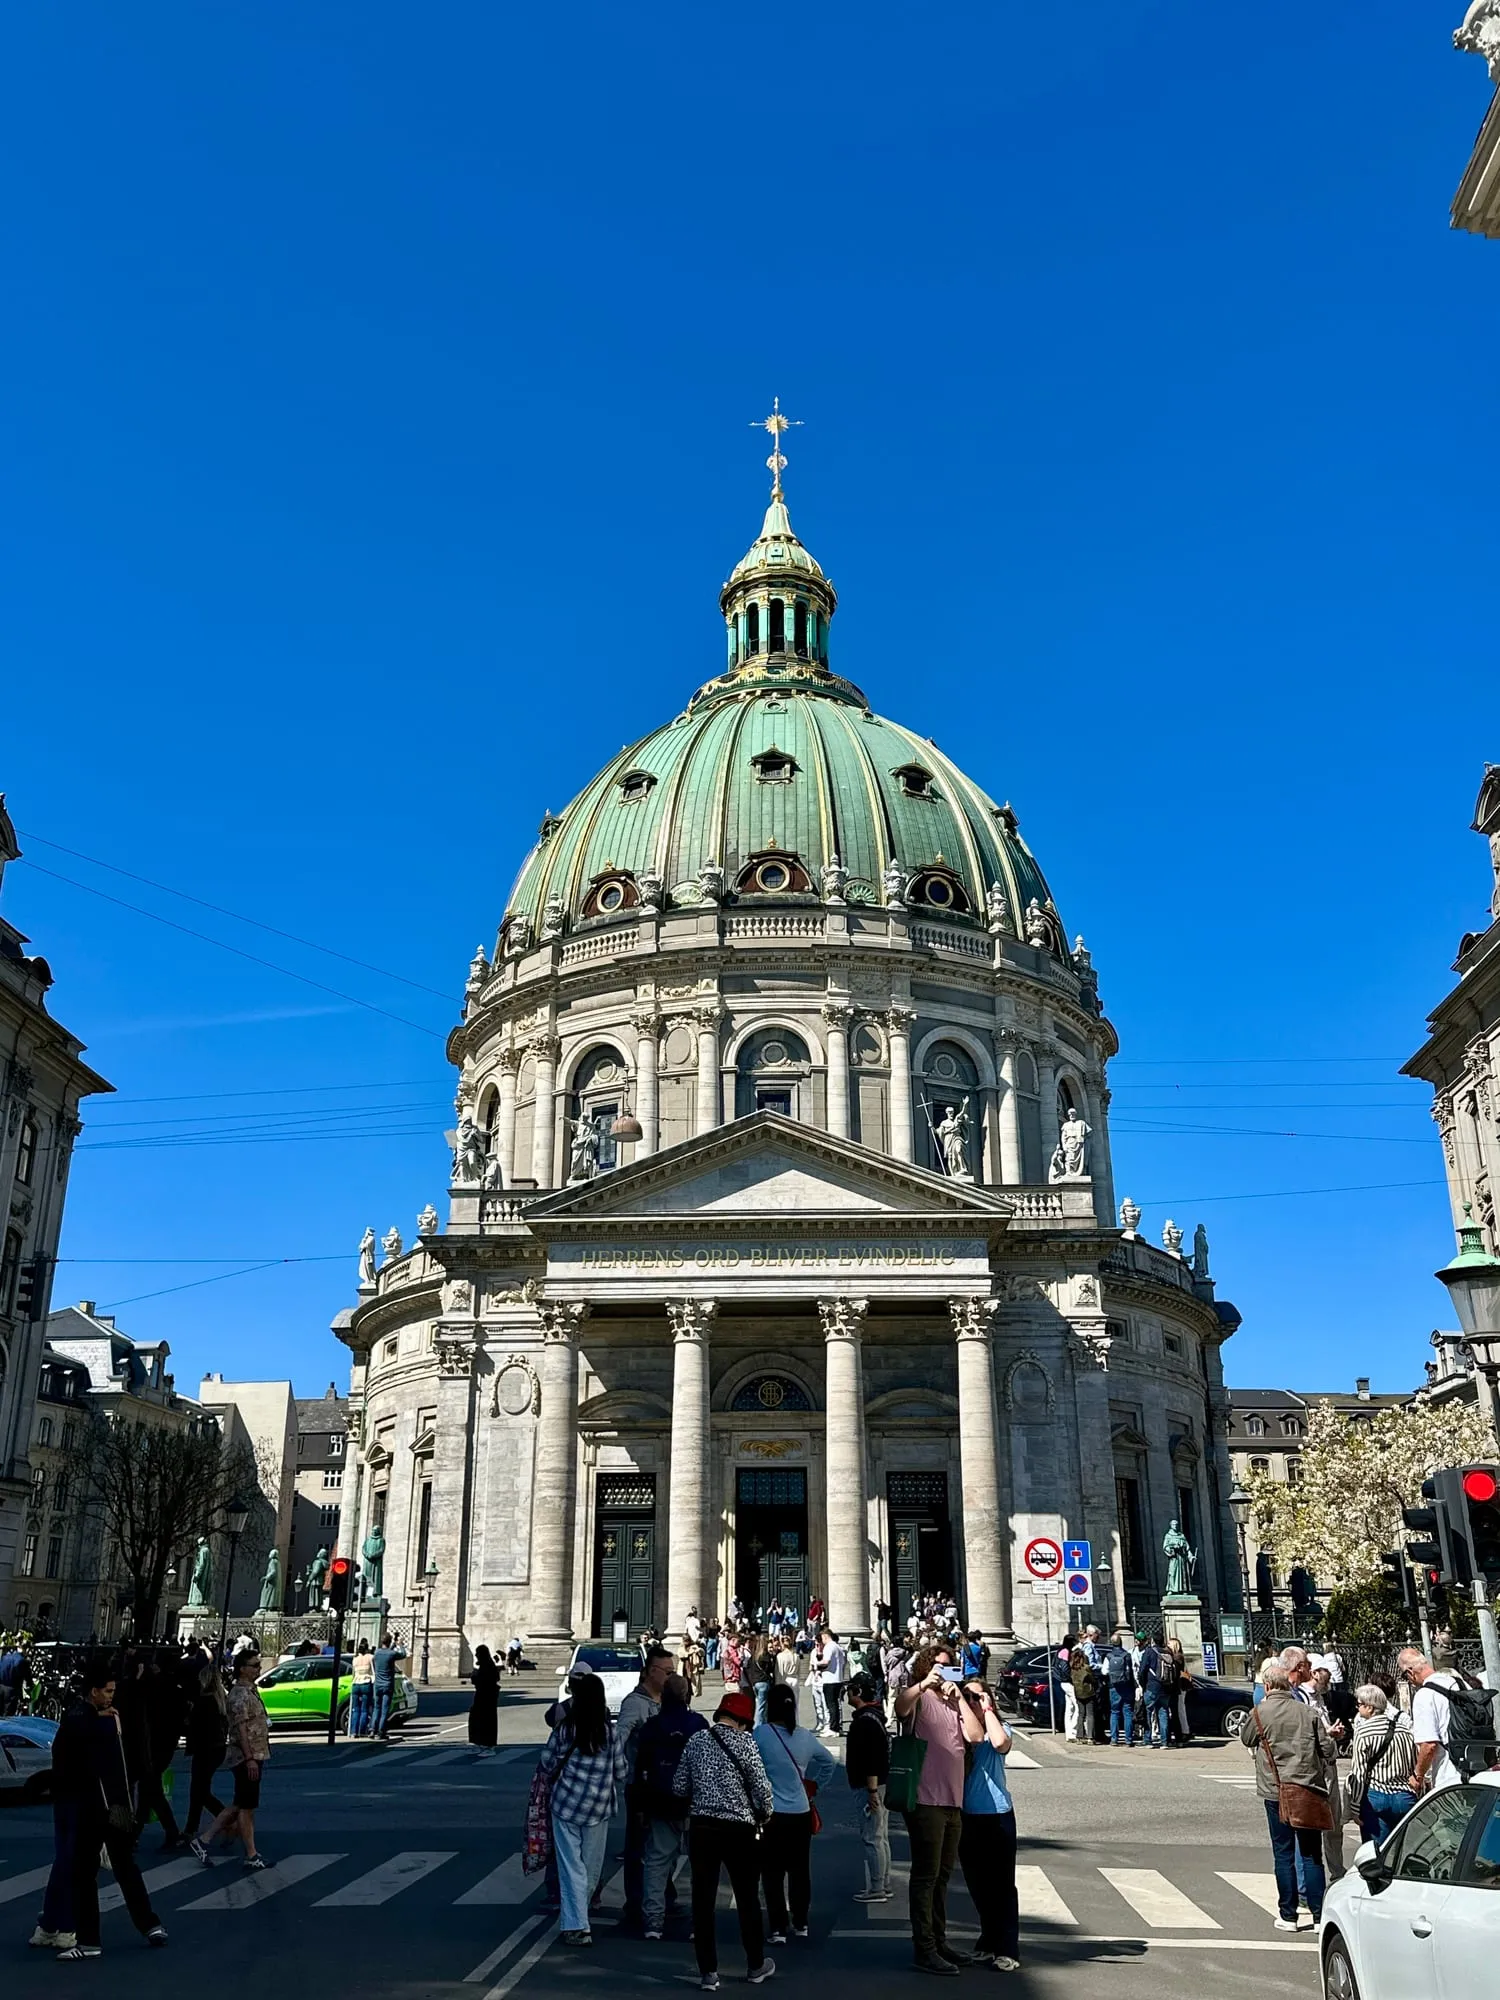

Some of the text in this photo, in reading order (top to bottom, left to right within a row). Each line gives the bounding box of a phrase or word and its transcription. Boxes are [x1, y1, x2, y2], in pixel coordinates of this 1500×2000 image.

[582, 1249, 684, 1269] HERRENS
[694, 1249, 740, 1268] ORD
[750, 1248, 830, 1267] BLIVER
